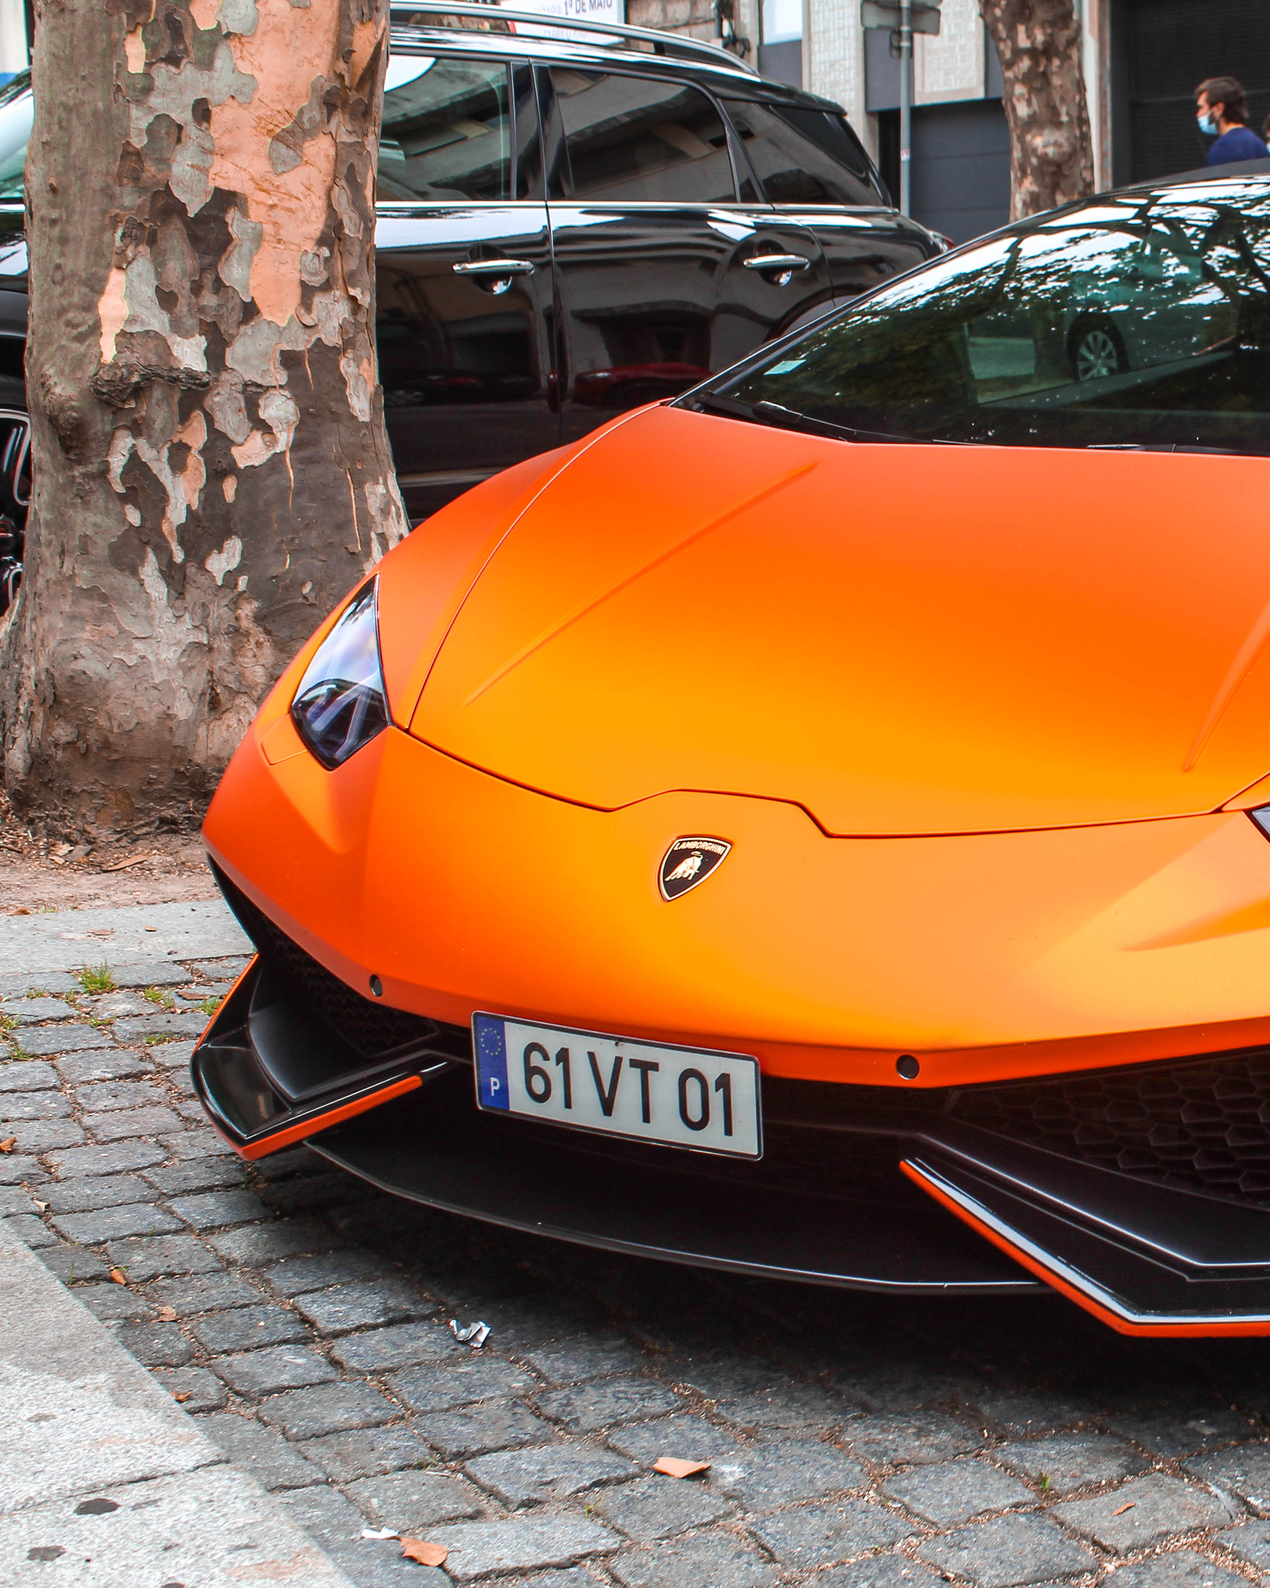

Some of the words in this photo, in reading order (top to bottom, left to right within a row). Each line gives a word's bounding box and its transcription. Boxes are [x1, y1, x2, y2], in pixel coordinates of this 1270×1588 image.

[575, 0, 587, 14] DE
[588, 0, 613, 11] MAIO
[673, 841, 727, 856] LAMBORGHINI
[489, 1077, 500, 1097] P
[523, 1042, 572, 1109] 61
[587, 1051, 660, 1124] VT
[677, 1067, 733, 1137] 01
